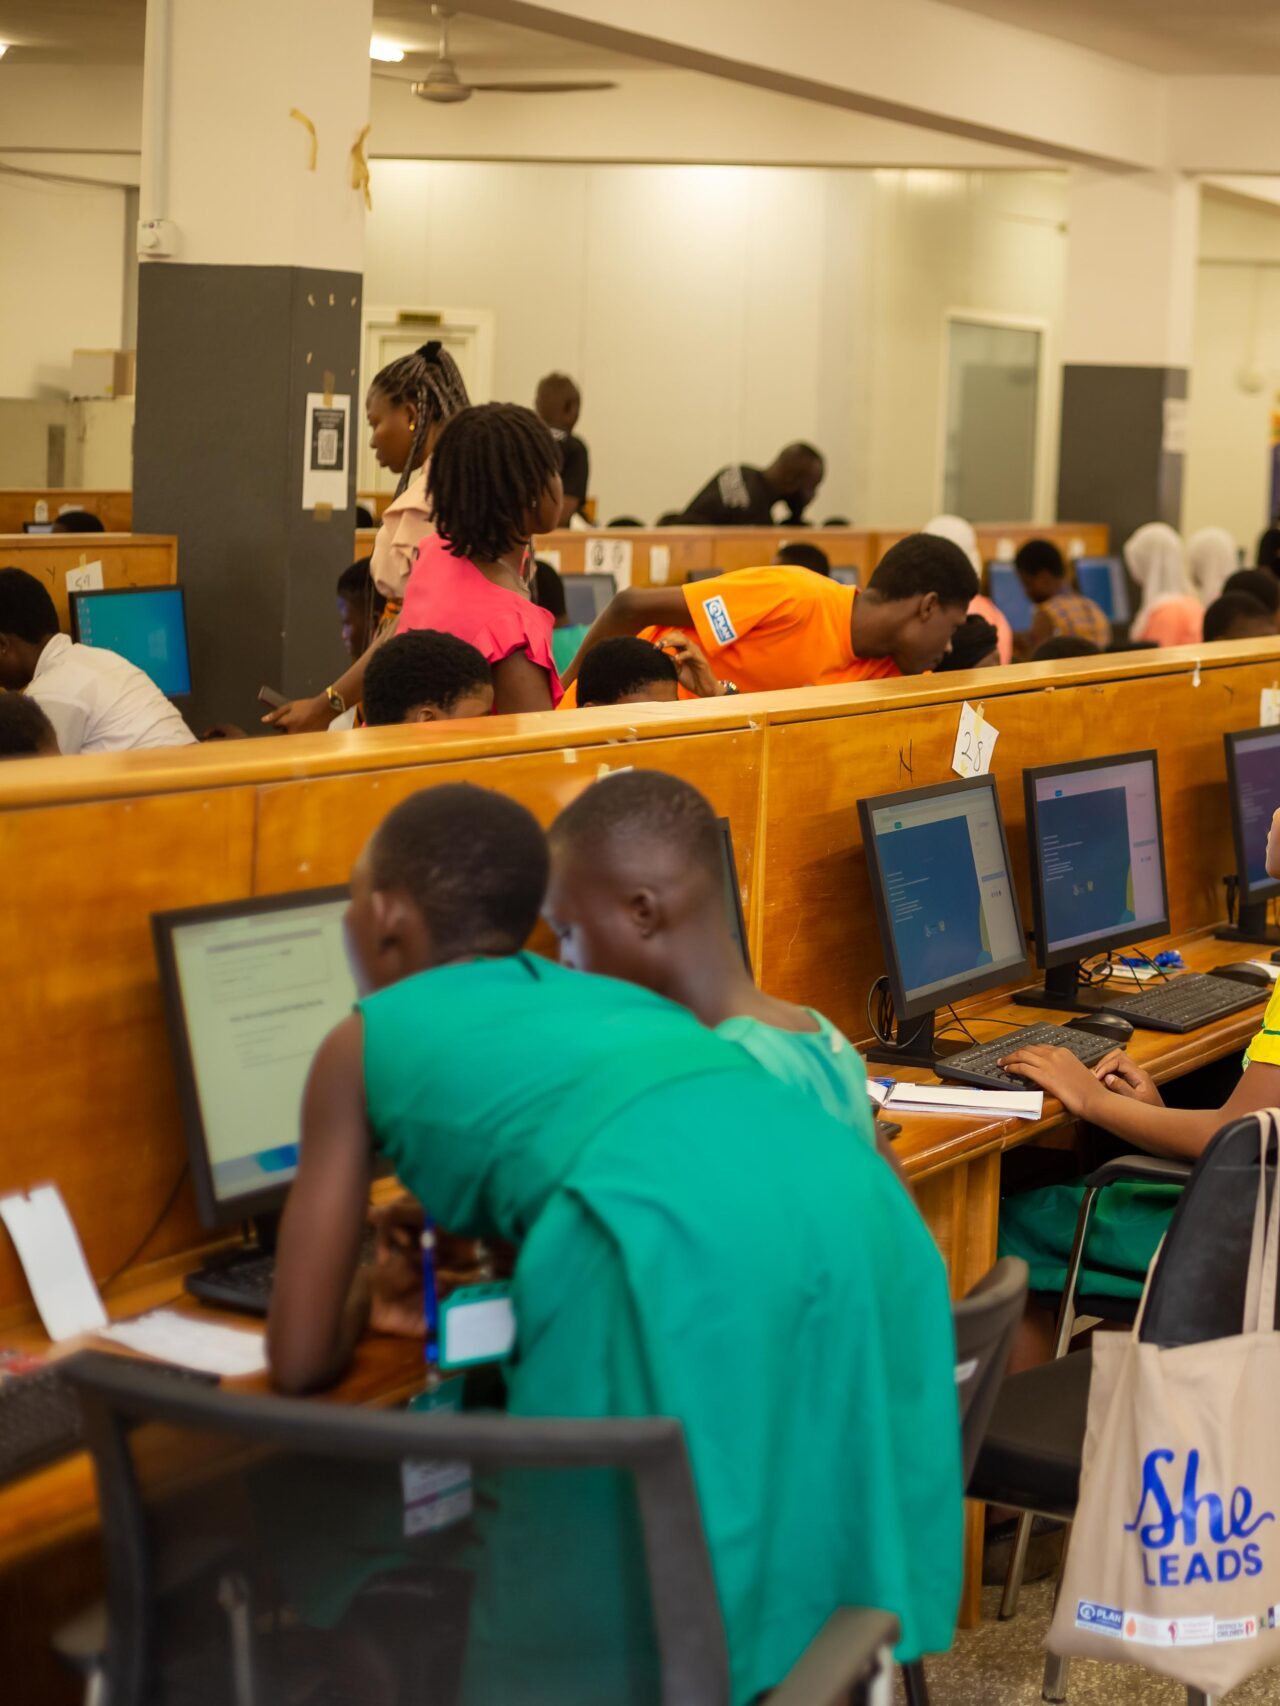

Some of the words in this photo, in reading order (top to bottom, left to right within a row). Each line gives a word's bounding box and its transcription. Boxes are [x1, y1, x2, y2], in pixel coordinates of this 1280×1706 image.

[1123, 1448, 1276, 1549] She
[1142, 1543, 1264, 1587] LEADS
[1095, 1608, 1122, 1624] PLAN
